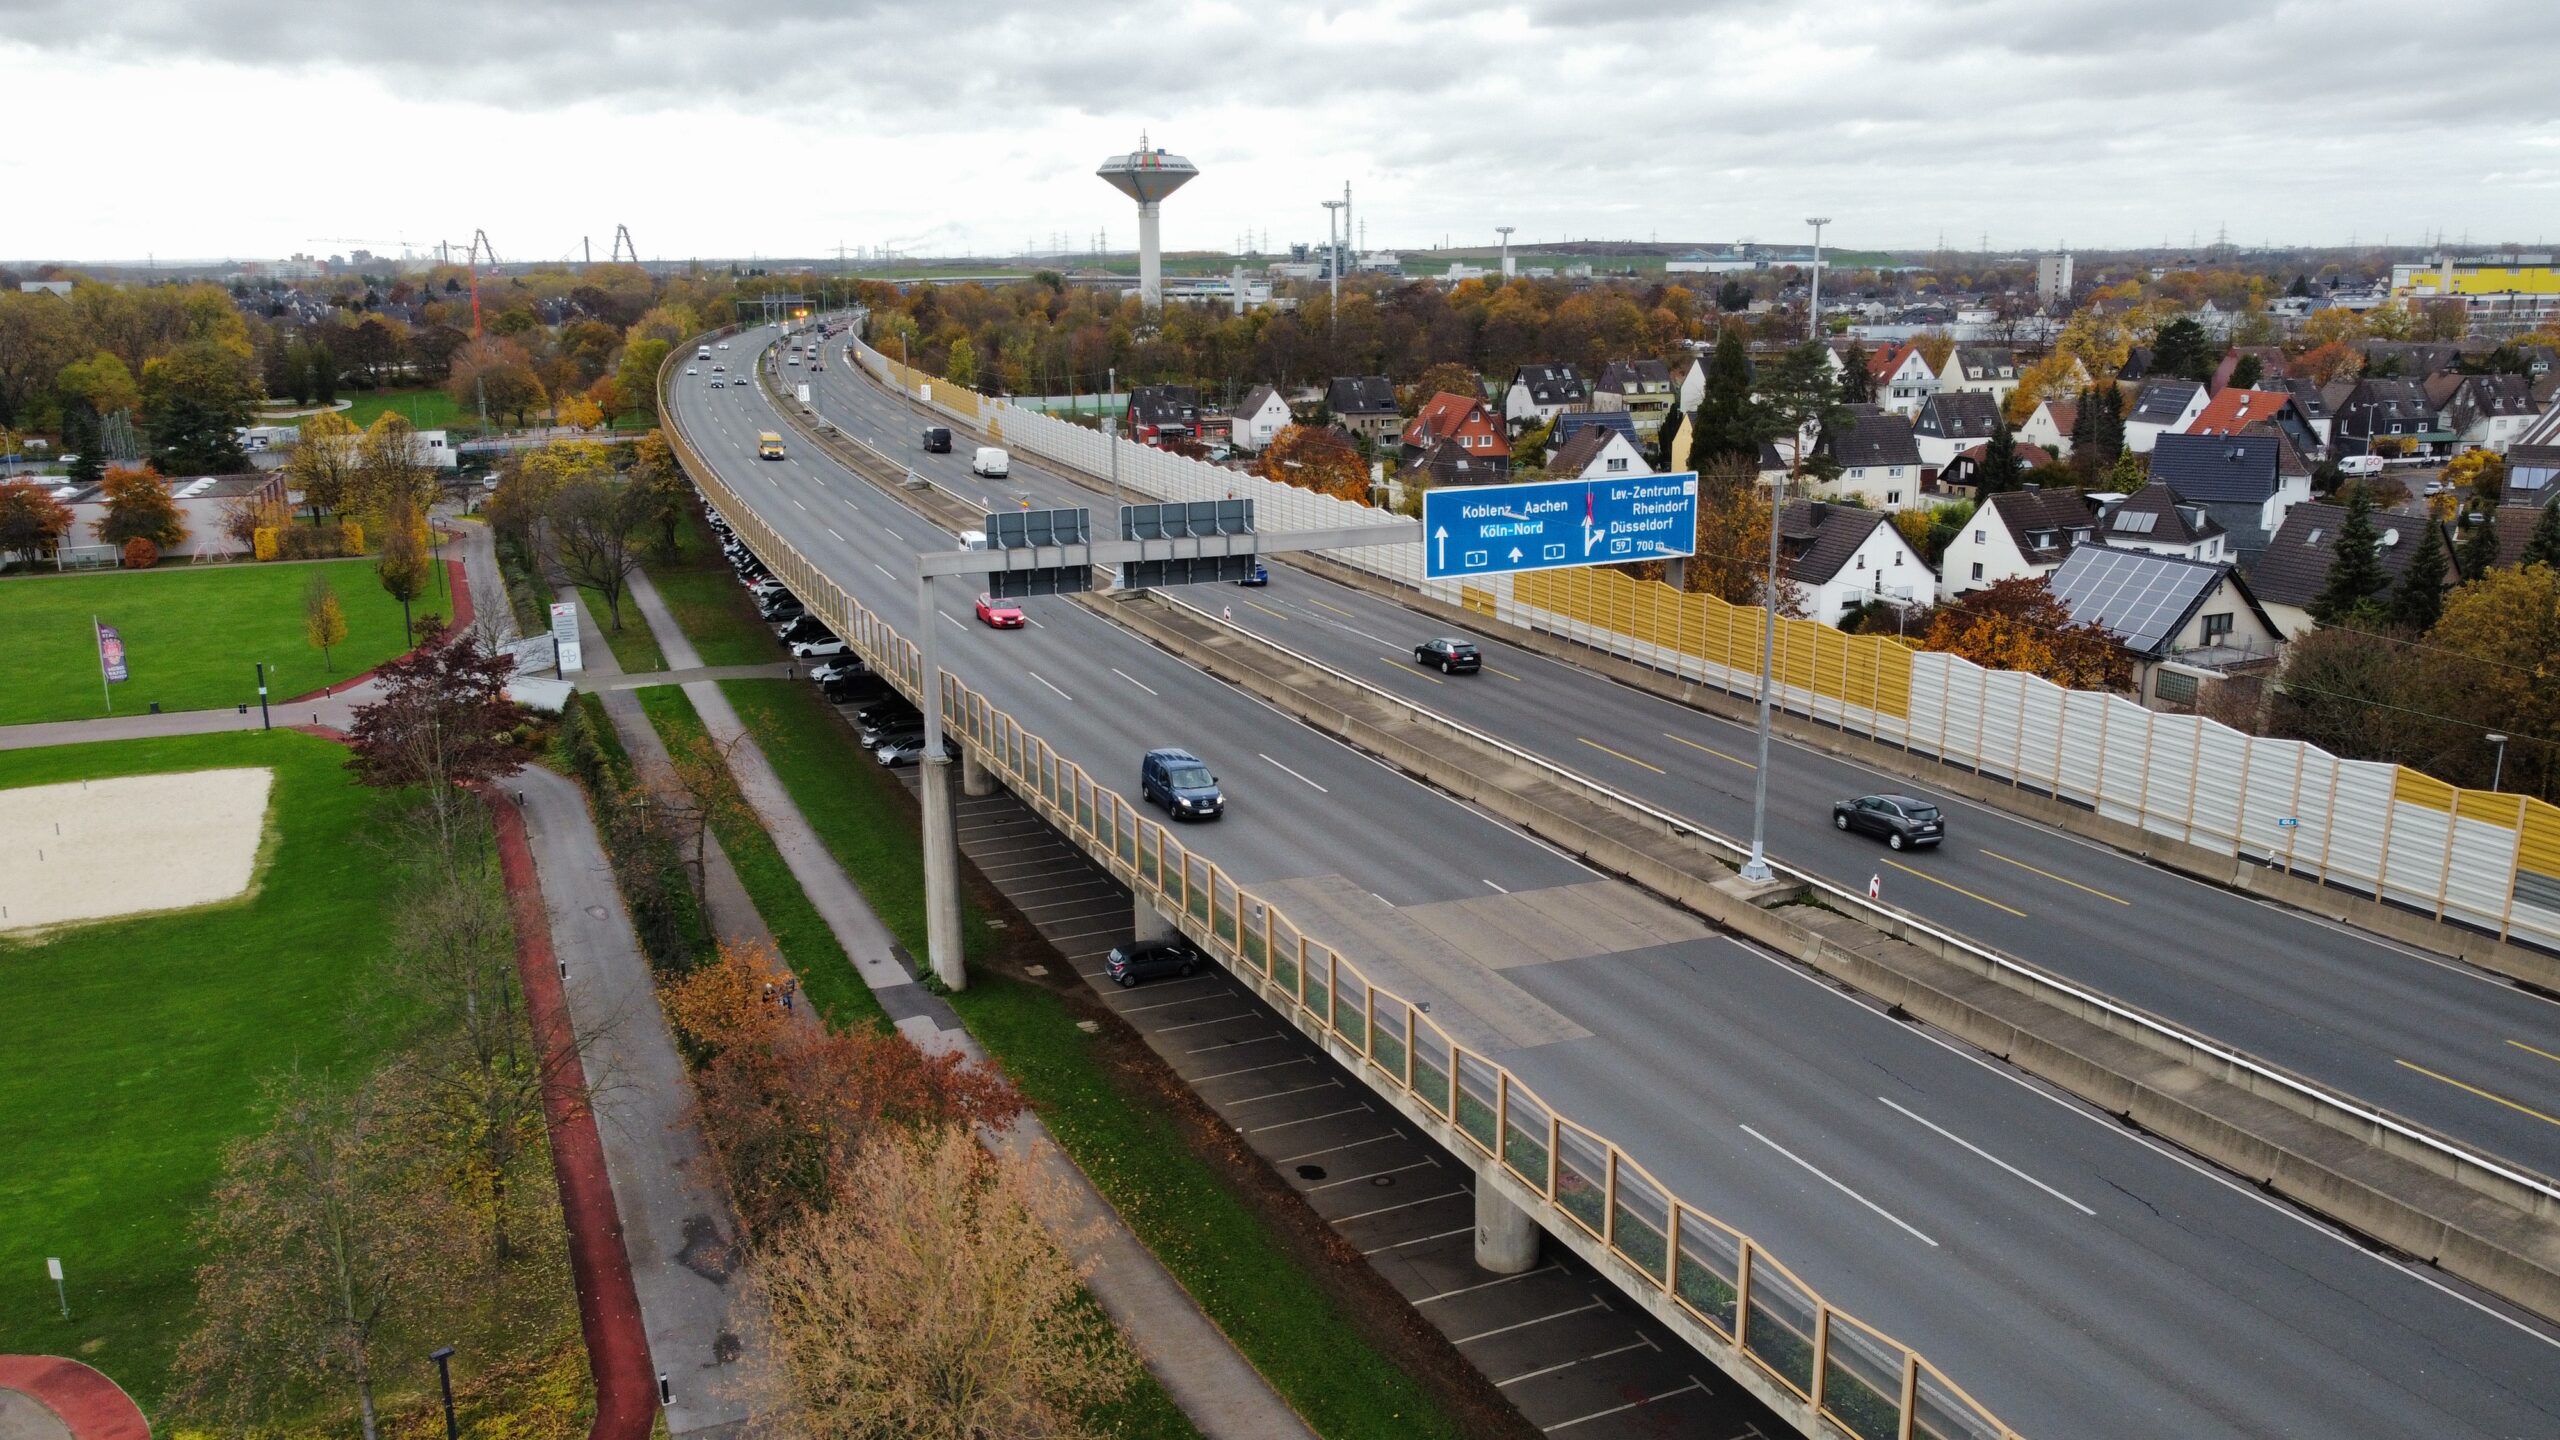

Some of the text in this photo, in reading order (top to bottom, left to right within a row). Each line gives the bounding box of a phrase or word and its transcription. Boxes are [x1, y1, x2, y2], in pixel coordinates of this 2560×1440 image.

[1611, 485, 1681, 501] Lev.-Zentrum
[1462, 500, 1568, 519] Koblenz Aachen
[1633, 499, 1689, 516] Rheindorf
[1480, 521, 1544, 539] Köln-Nord
[1611, 517, 1674, 534] Düsseldorf
[1615, 541, 1626, 551] 59
[1636, 540, 1654, 552] 700
